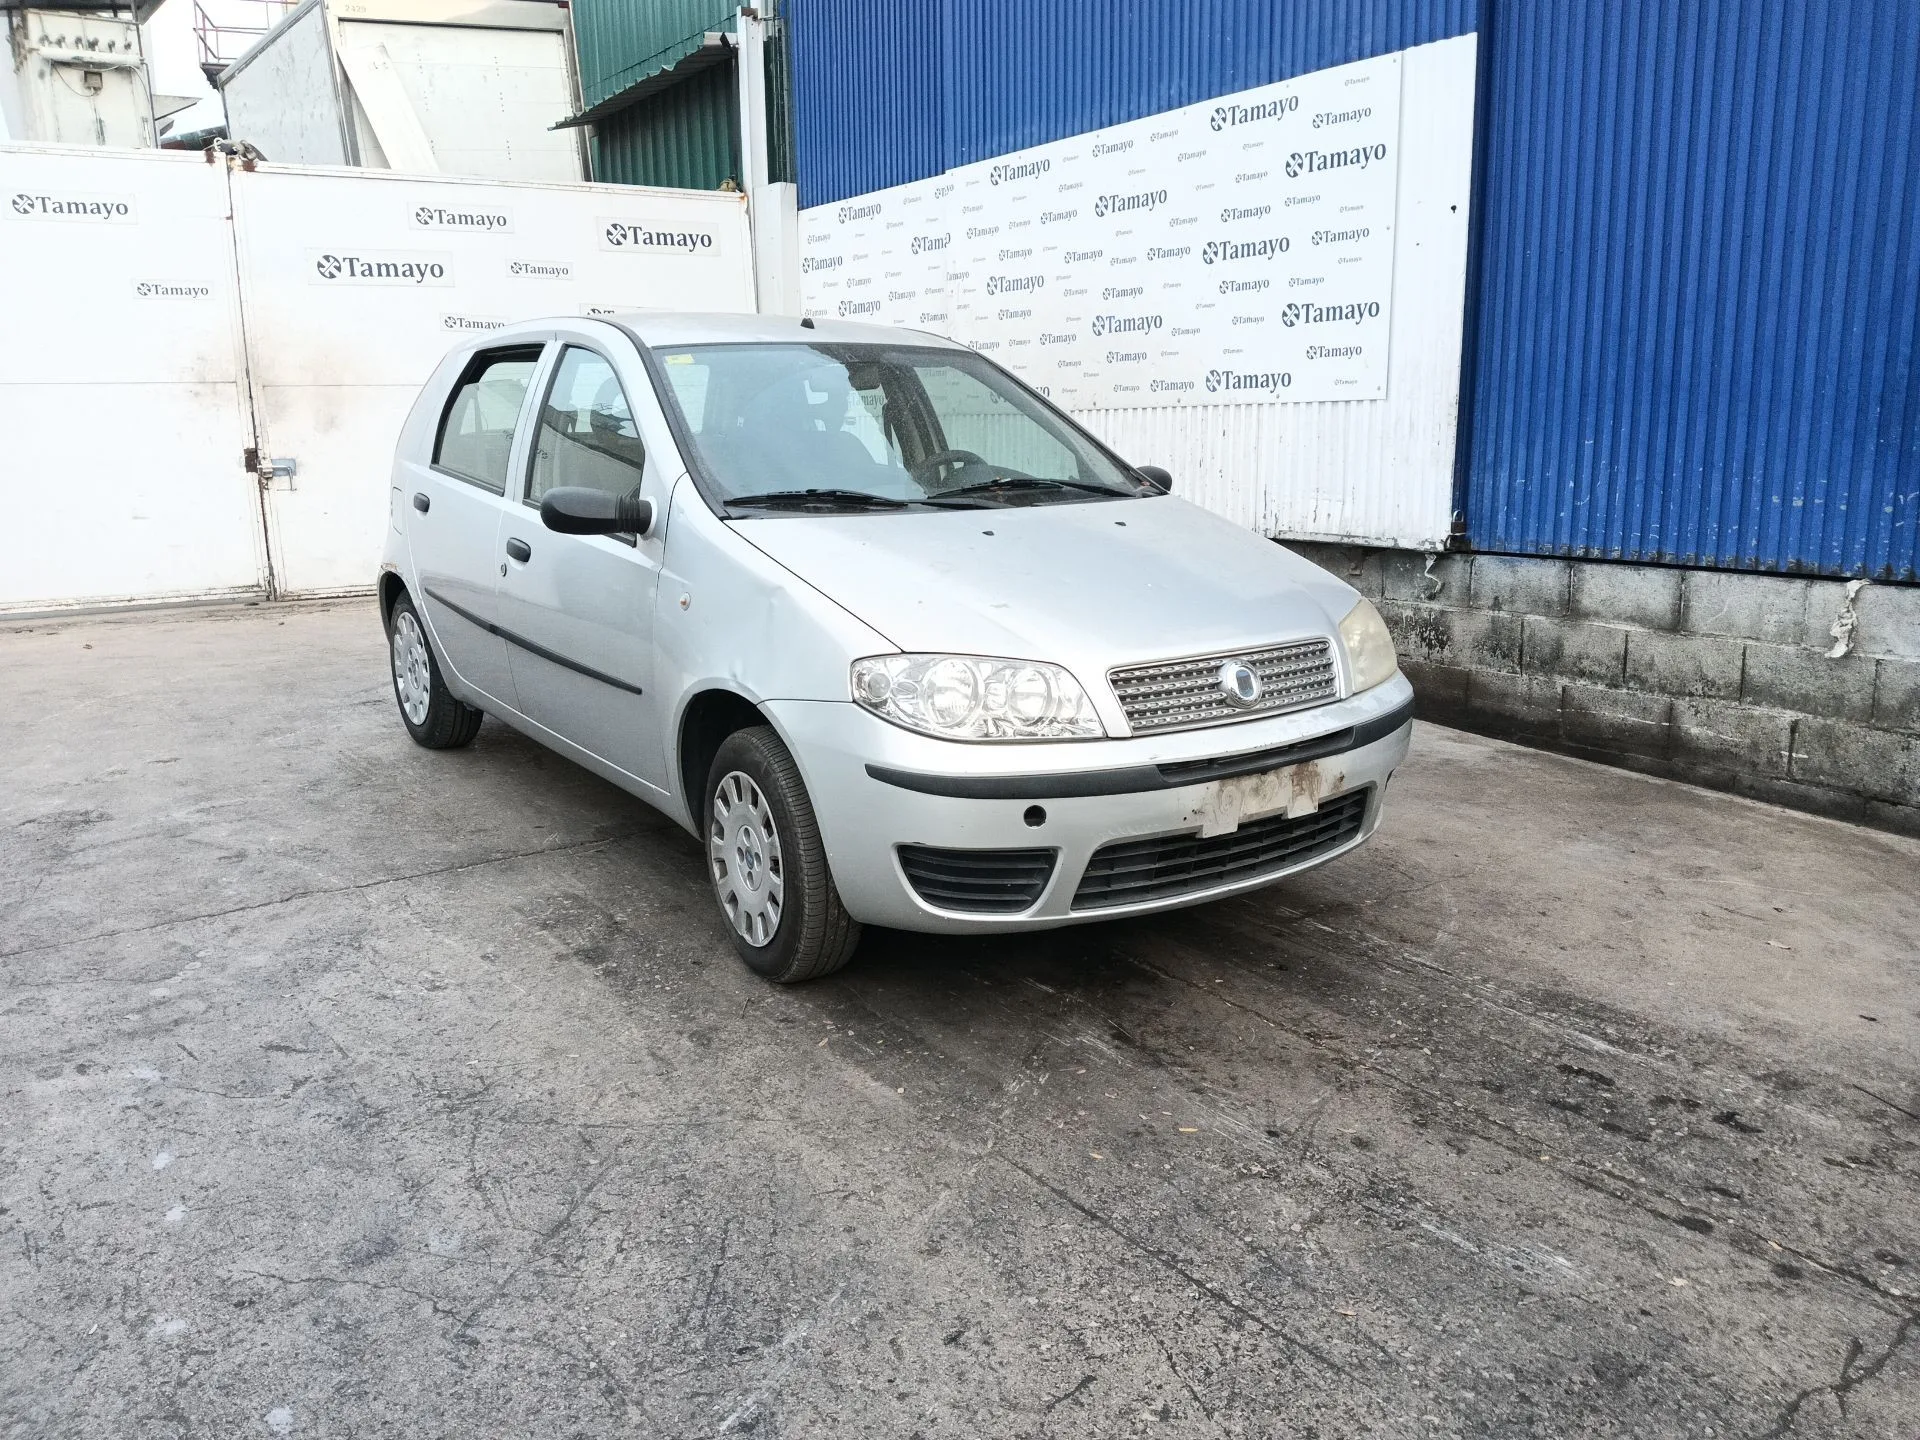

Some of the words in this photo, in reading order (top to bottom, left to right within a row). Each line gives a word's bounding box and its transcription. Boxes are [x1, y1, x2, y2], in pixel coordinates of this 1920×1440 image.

[1228, 96, 1298, 126] Tamayo
[1324, 107, 1372, 126] Tamayo
[1156, 129, 1179, 140] Tamayo
[1101, 140, 1134, 155] Tamayo
[1183, 150, 1207, 161] Tamayo
[1305, 143, 1386, 173] Tamayo
[1002, 159, 1050, 182] Tamayo
[1242, 171, 1268, 182] Tamayo
[1109, 189, 1167, 213] Tamayo
[1292, 194, 1321, 205] Tamayo
[36, 196, 129, 221] Tamayo
[847, 203, 882, 221] Tamayo
[1047, 209, 1077, 222] Tamayo
[1230, 205, 1271, 220] Tamayo
[435, 209, 507, 230] Tamayo
[1175, 216, 1198, 226] Tamayo
[973, 226, 999, 237] Tamayo
[1323, 227, 1370, 243] Tamayo
[629, 226, 713, 253] Tamayo
[1005, 248, 1032, 260] Tamayo
[1072, 249, 1103, 262] Tamayo
[1156, 246, 1191, 259] Tamayo
[1219, 236, 1290, 261] Tamayo
[343, 257, 444, 283] Tamayo
[522, 264, 569, 277] Tamayo
[811, 256, 842, 271] Tamayo
[998, 275, 1044, 293] Tamayo
[1229, 279, 1269, 293] Tamayo
[1296, 276, 1325, 286] Tamayo
[151, 283, 209, 298] Tamayo
[893, 290, 916, 301] Tamayo
[1110, 287, 1143, 299] Tamayo
[847, 300, 880, 315] Tamayo
[1005, 309, 1032, 320] Tamayo
[1301, 301, 1380, 326] Tamayo
[1105, 315, 1163, 335] Tamayo
[1239, 316, 1265, 325] Tamayo
[1177, 327, 1200, 336] Tamayo
[975, 341, 1000, 351] Tamayo
[1048, 334, 1077, 345] Tamayo
[1115, 351, 1147, 363] Tamayo
[1317, 345, 1362, 360] Tamayo
[1119, 384, 1140, 392] Tamayo
[1159, 380, 1194, 392] Tamayo
[1222, 370, 1292, 394] Tamayo
